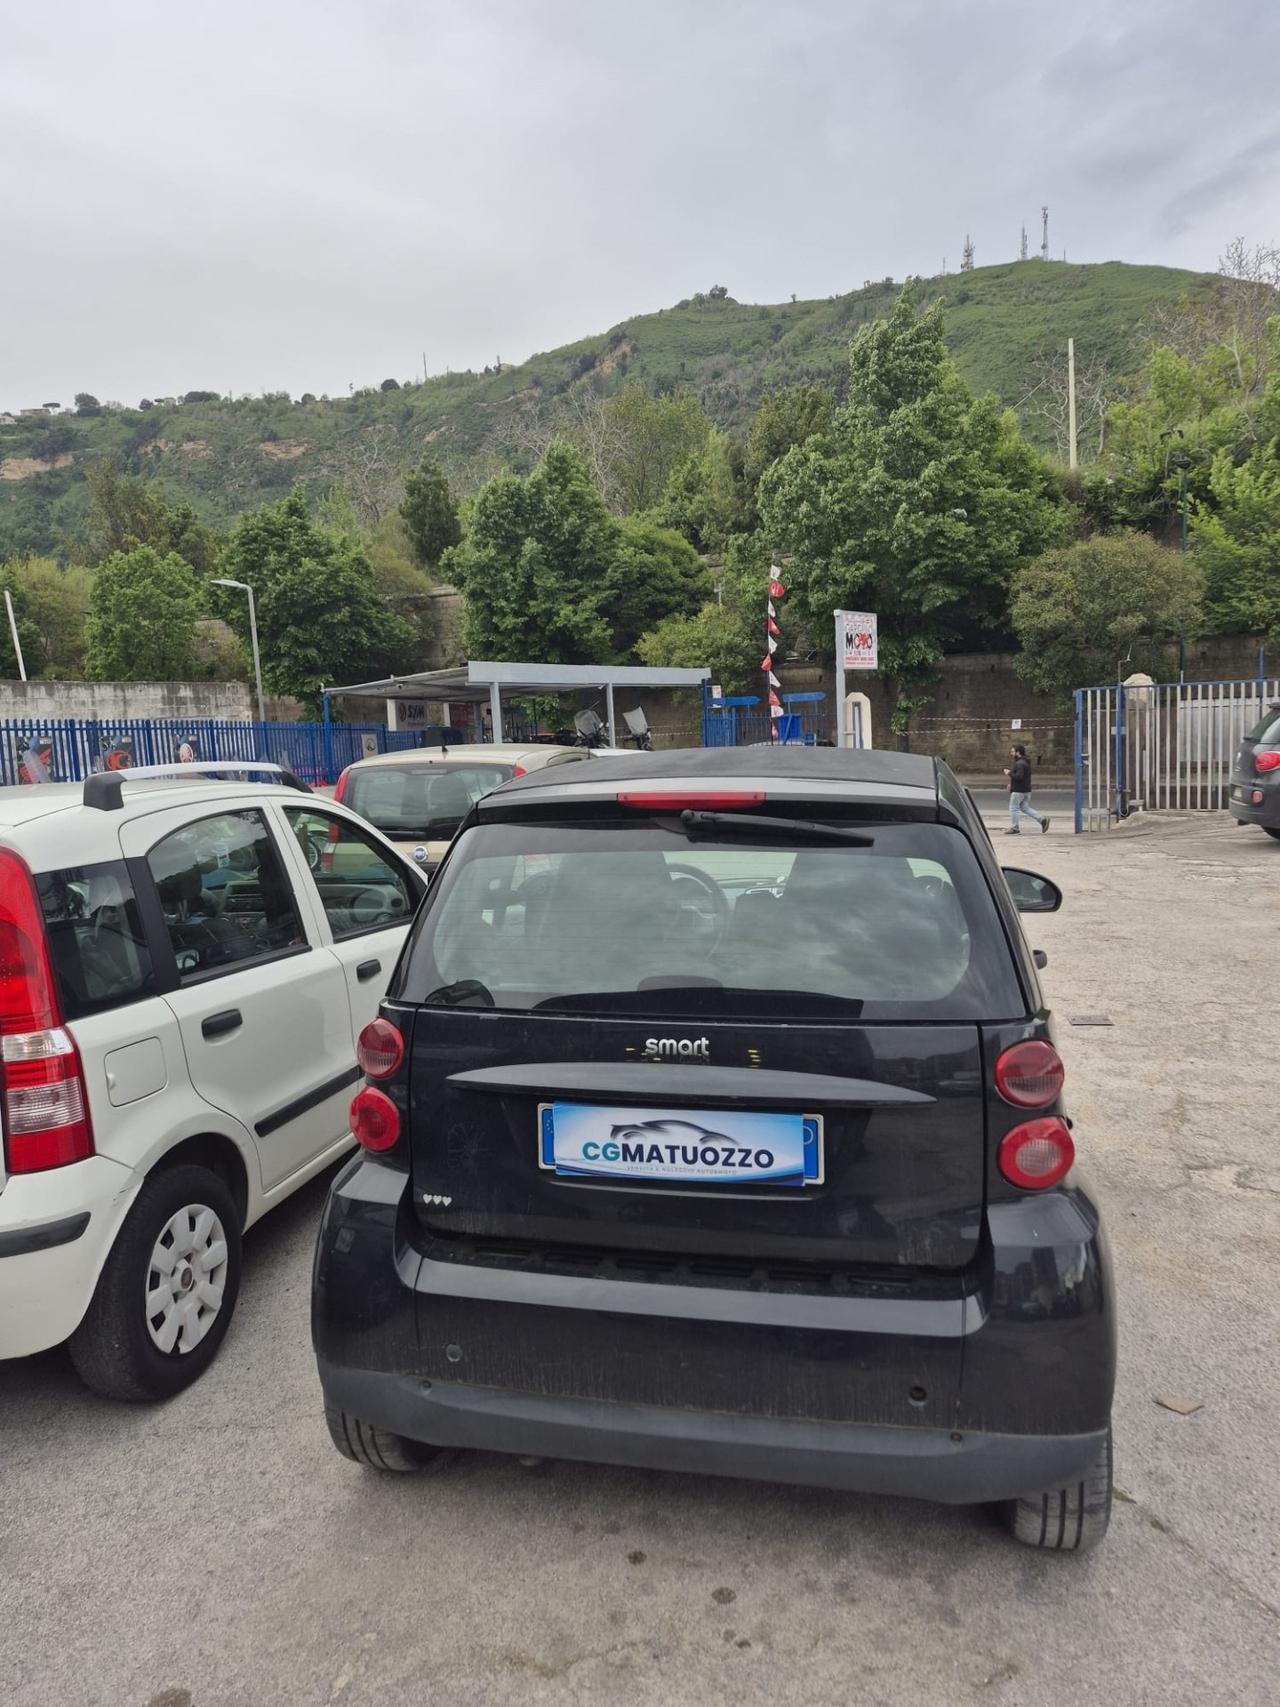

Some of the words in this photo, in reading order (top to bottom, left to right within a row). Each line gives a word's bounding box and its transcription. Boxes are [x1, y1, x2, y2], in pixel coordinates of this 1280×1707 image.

[408, 704, 425, 720] SYM
[645, 1037, 709, 1055] smart
[582, 1141, 775, 1169] CGMATUOZZO
